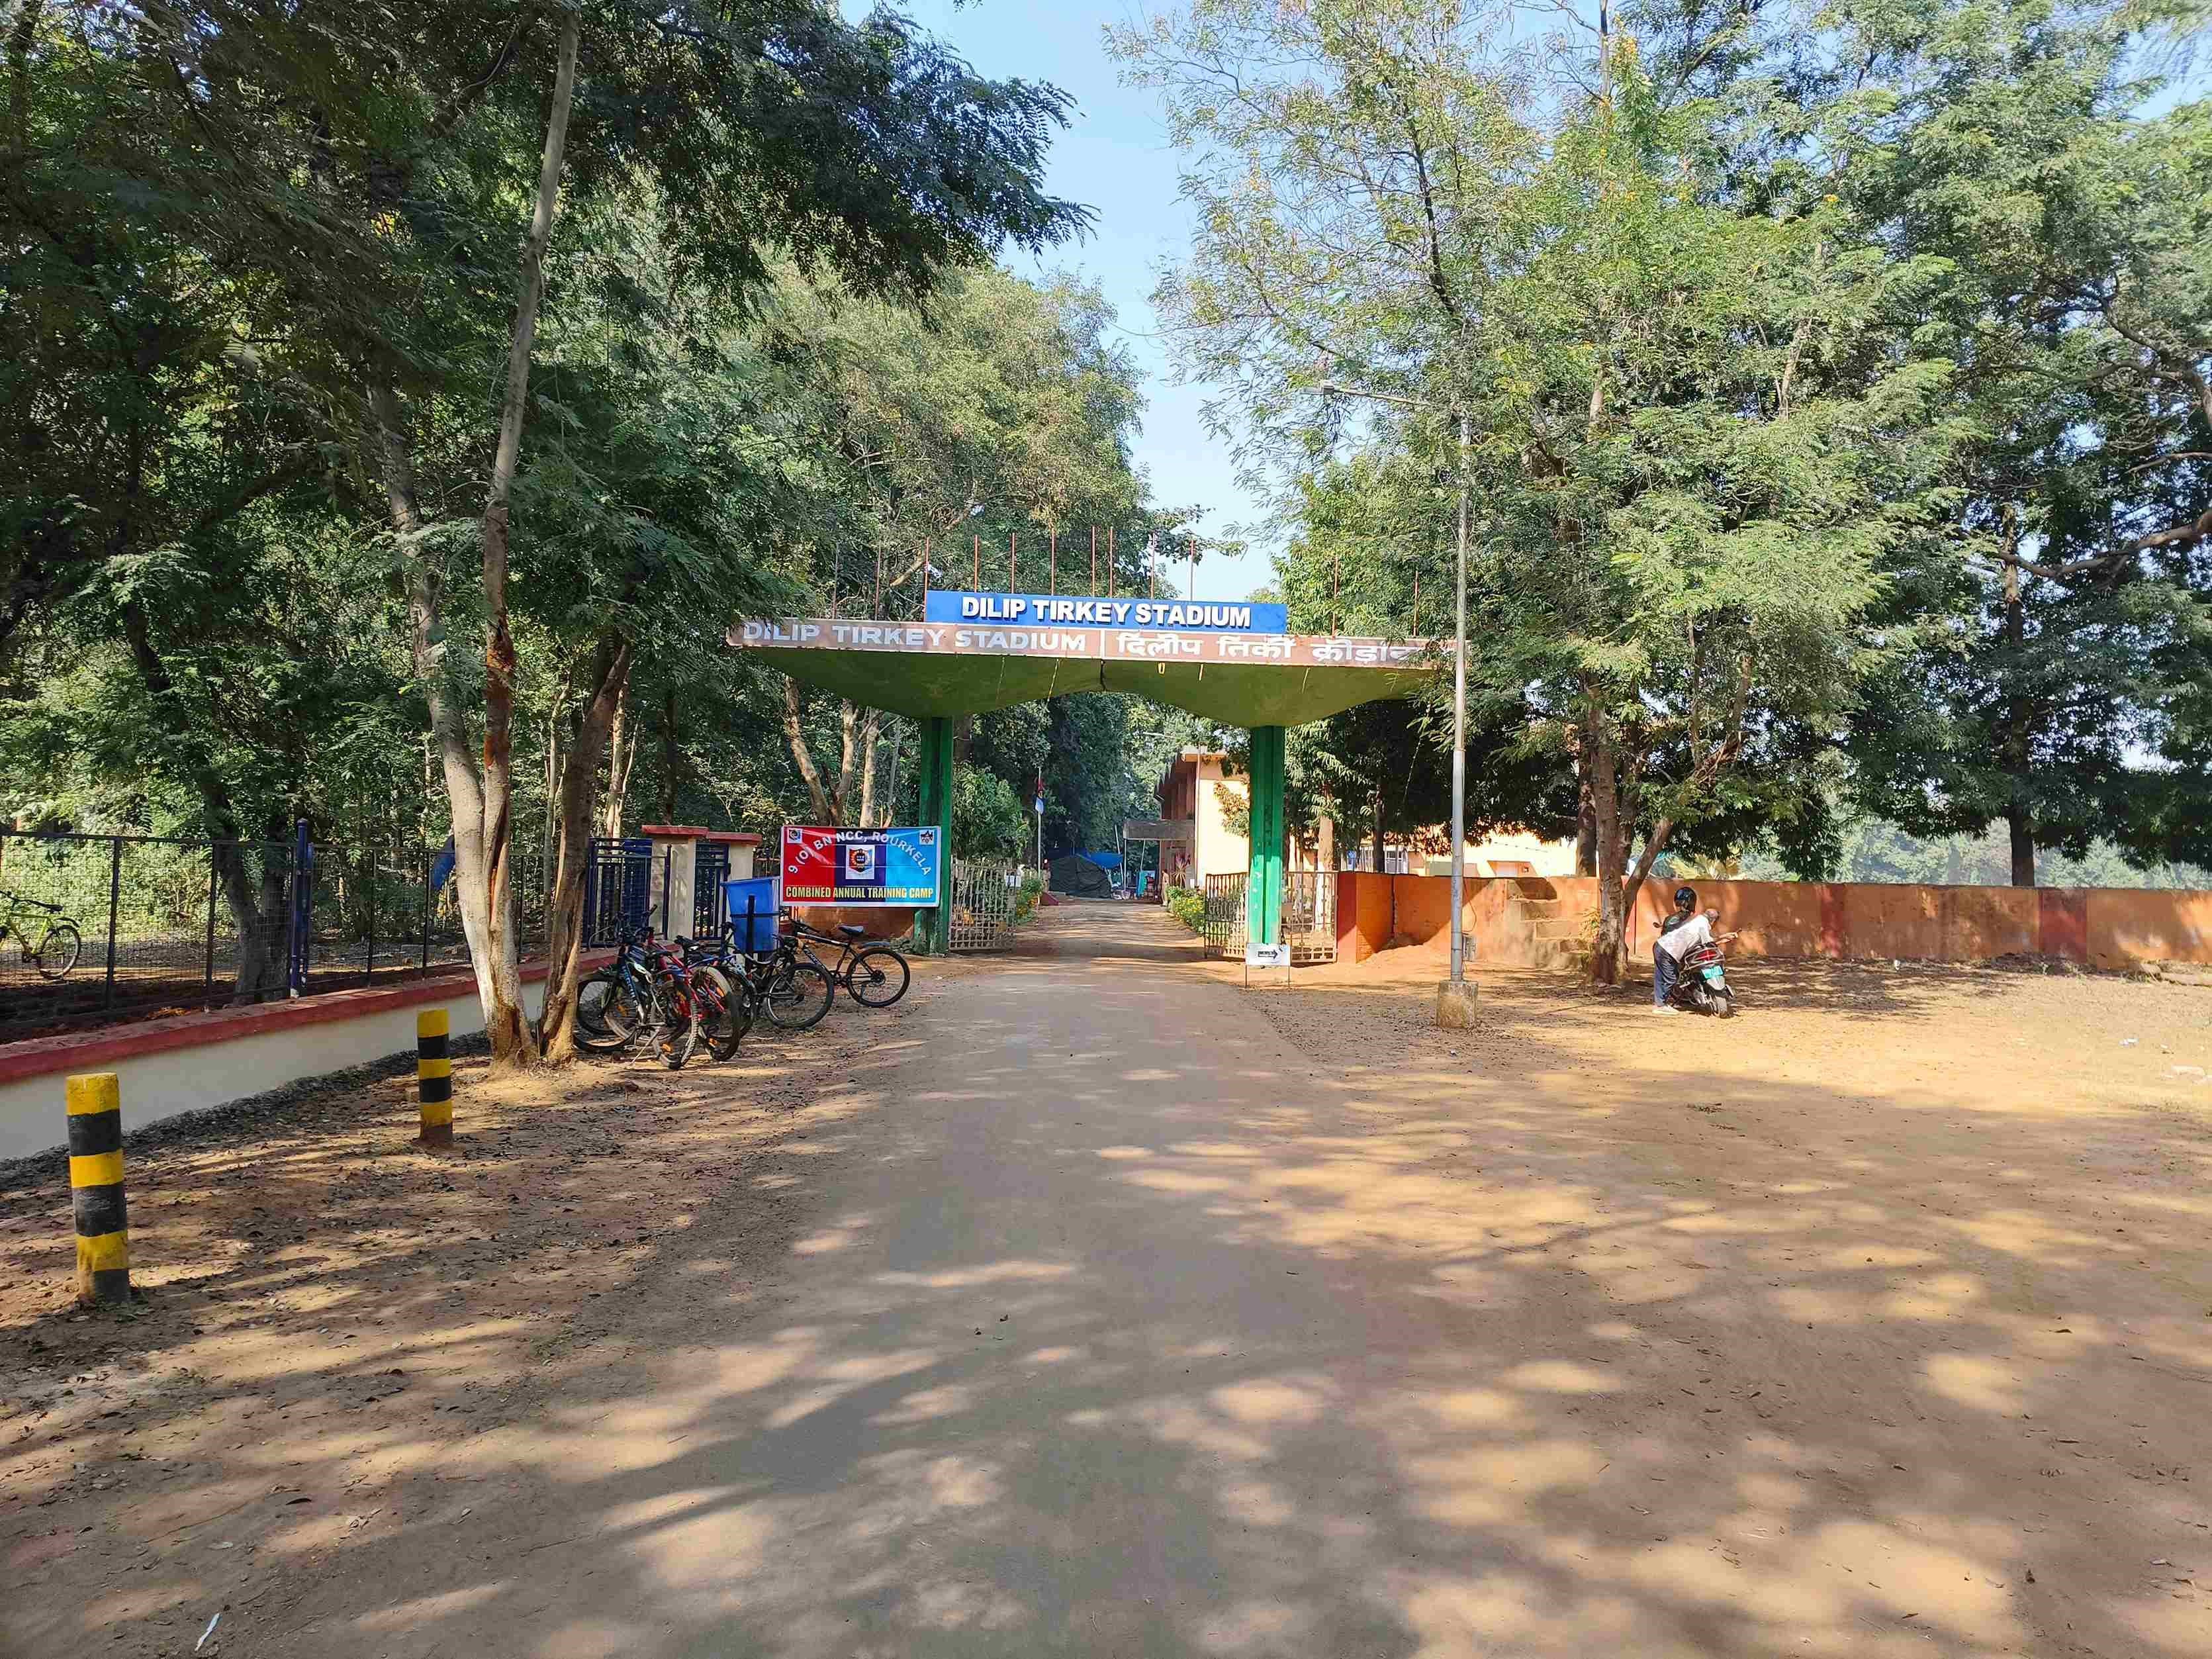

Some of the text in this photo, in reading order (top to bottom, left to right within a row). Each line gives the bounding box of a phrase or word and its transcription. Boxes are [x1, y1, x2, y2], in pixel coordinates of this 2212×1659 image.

[962, 596, 1251, 629] DILIP TIRKEY STADIUM
[742, 621, 1086, 652] DILIP TIRKEY STADIUM
[1115, 631, 1205, 658] दिलीप
[788, 865, 799, 875] 9
[813, 836, 833, 850] BN
[872, 831, 932, 876] ROURKELA
[785, 886, 934, 899] COMBINED ANNUAL TRAINING CAMP
